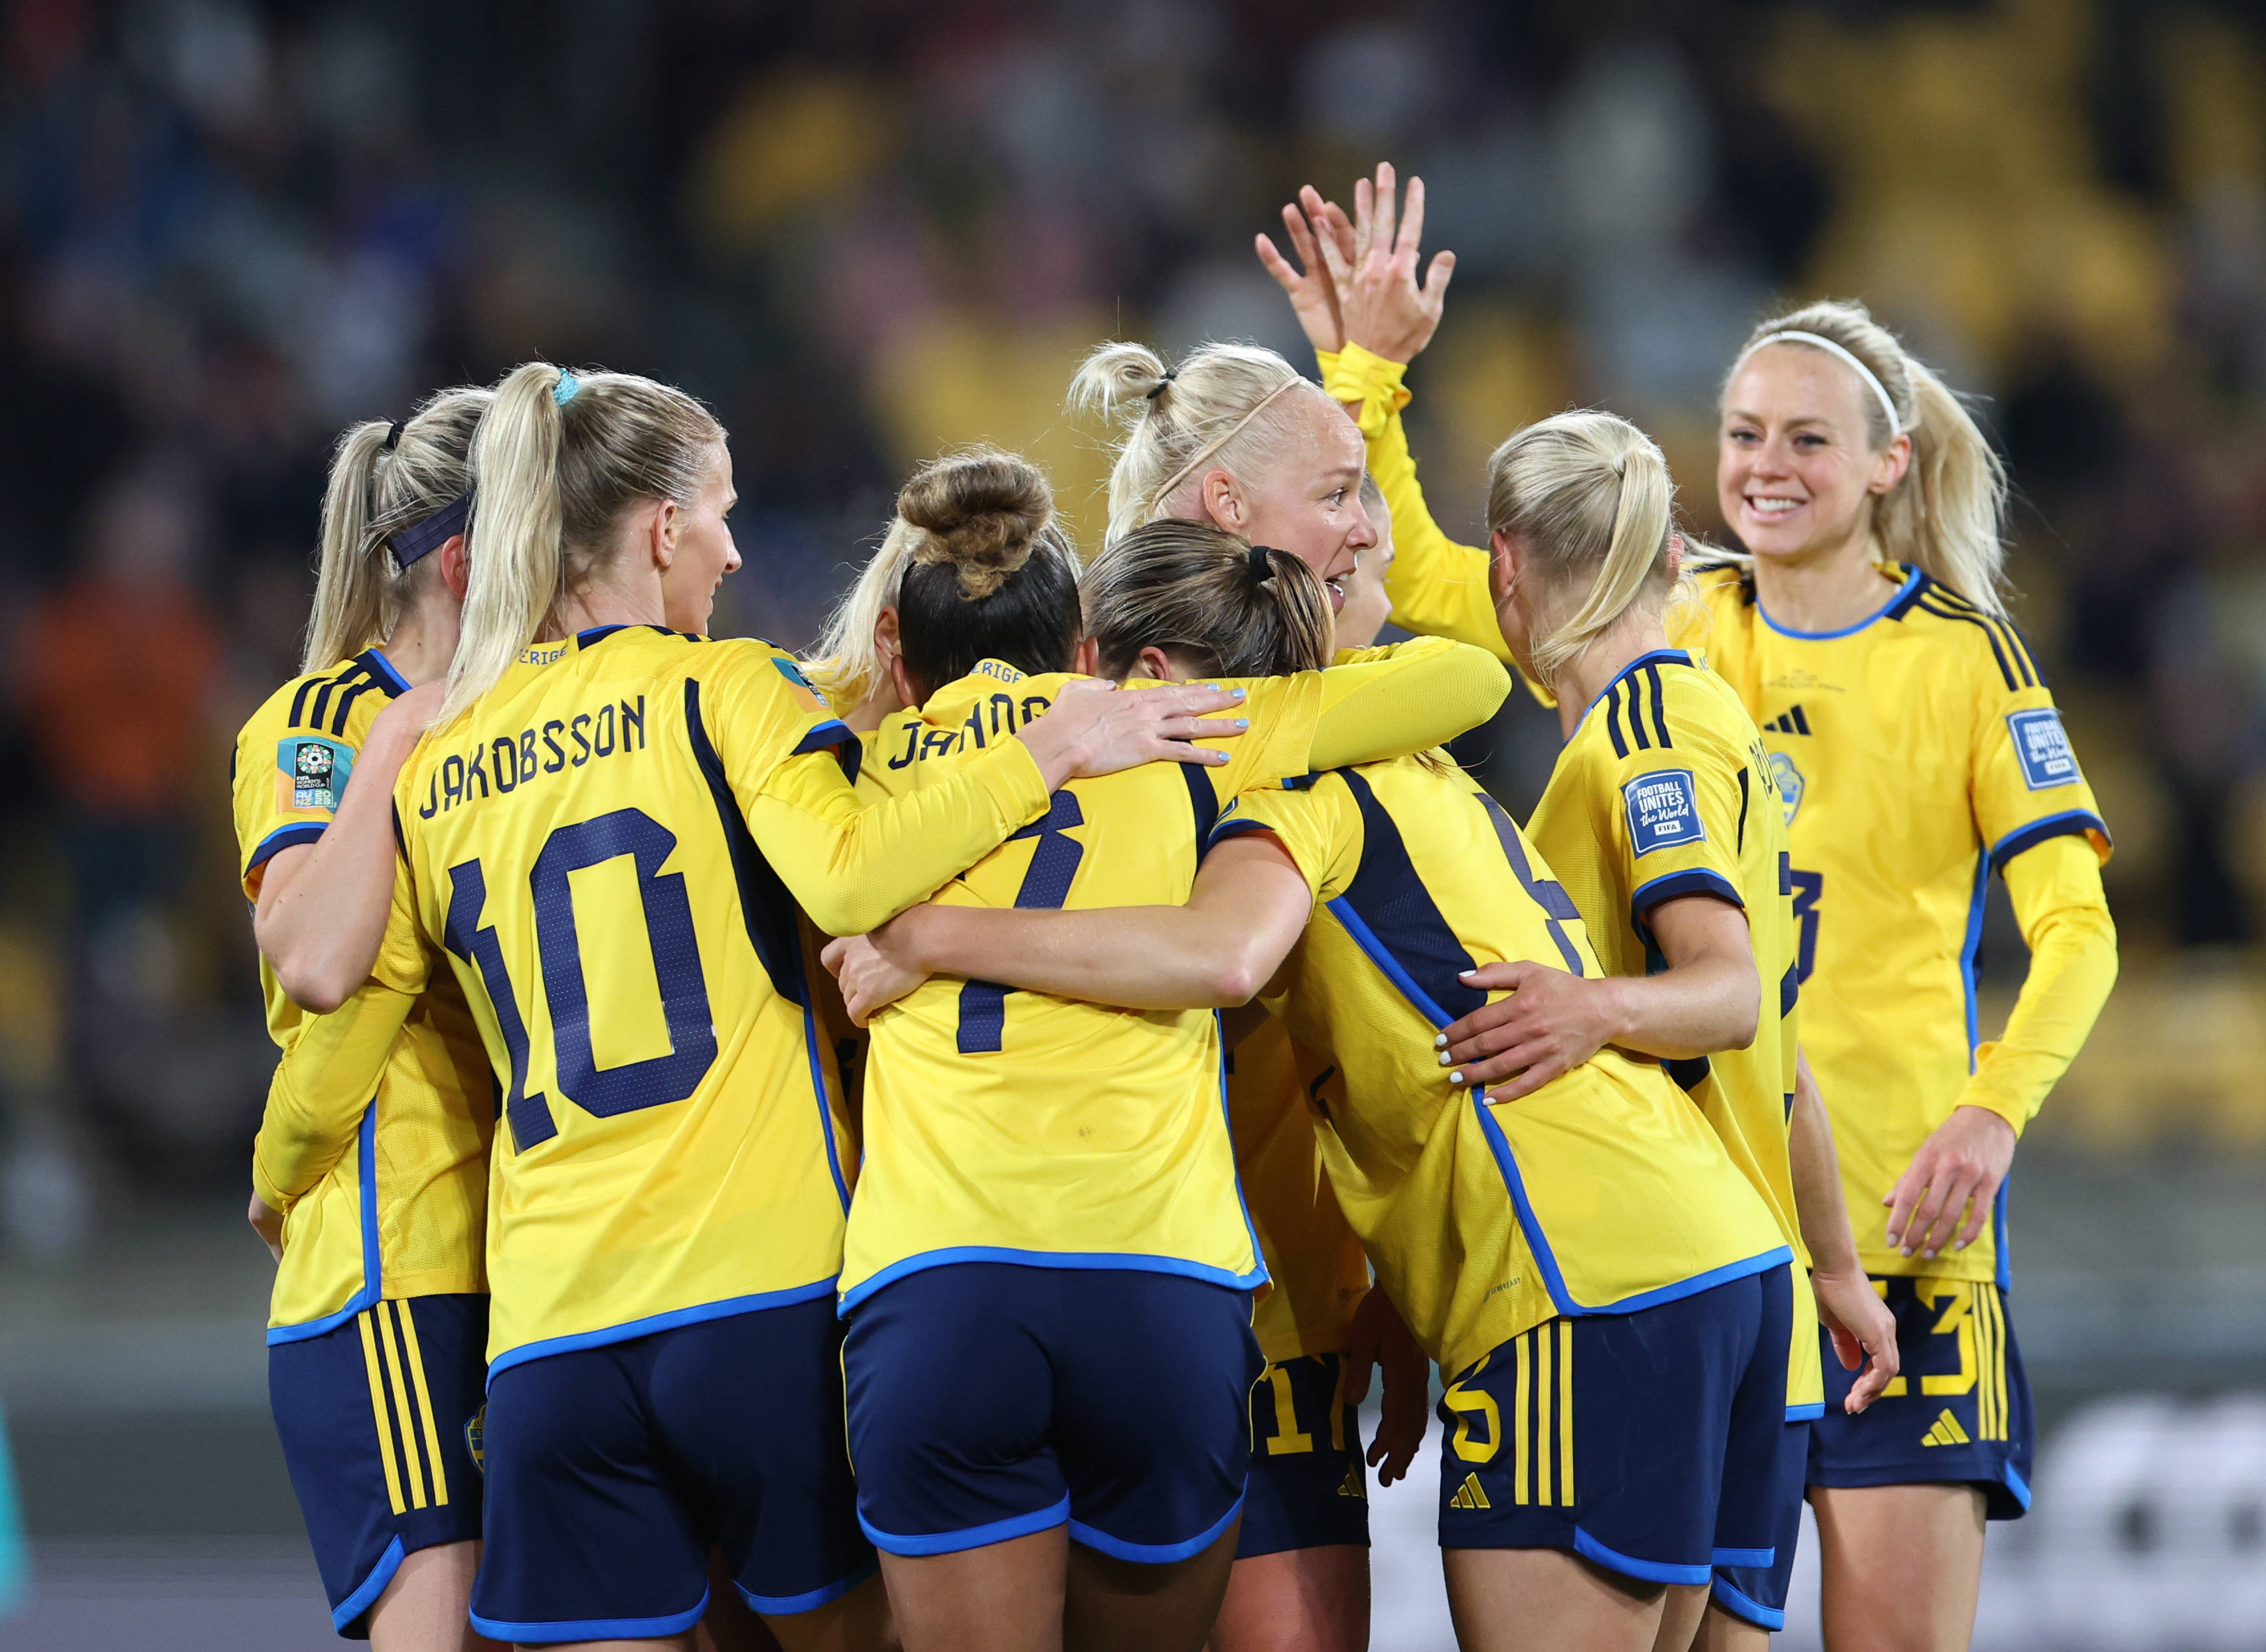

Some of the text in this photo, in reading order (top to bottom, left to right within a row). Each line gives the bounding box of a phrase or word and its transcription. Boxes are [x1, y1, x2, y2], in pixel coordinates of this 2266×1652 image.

[419, 695, 645, 820] JAKOBSSON
[1637, 781, 1681, 800] FOOTBALL
[1638, 790, 1685, 813] UNITES
[1639, 803, 1689, 827] the World
[1658, 824, 1677, 832] FIFA
[444, 807, 718, 1157] 10
